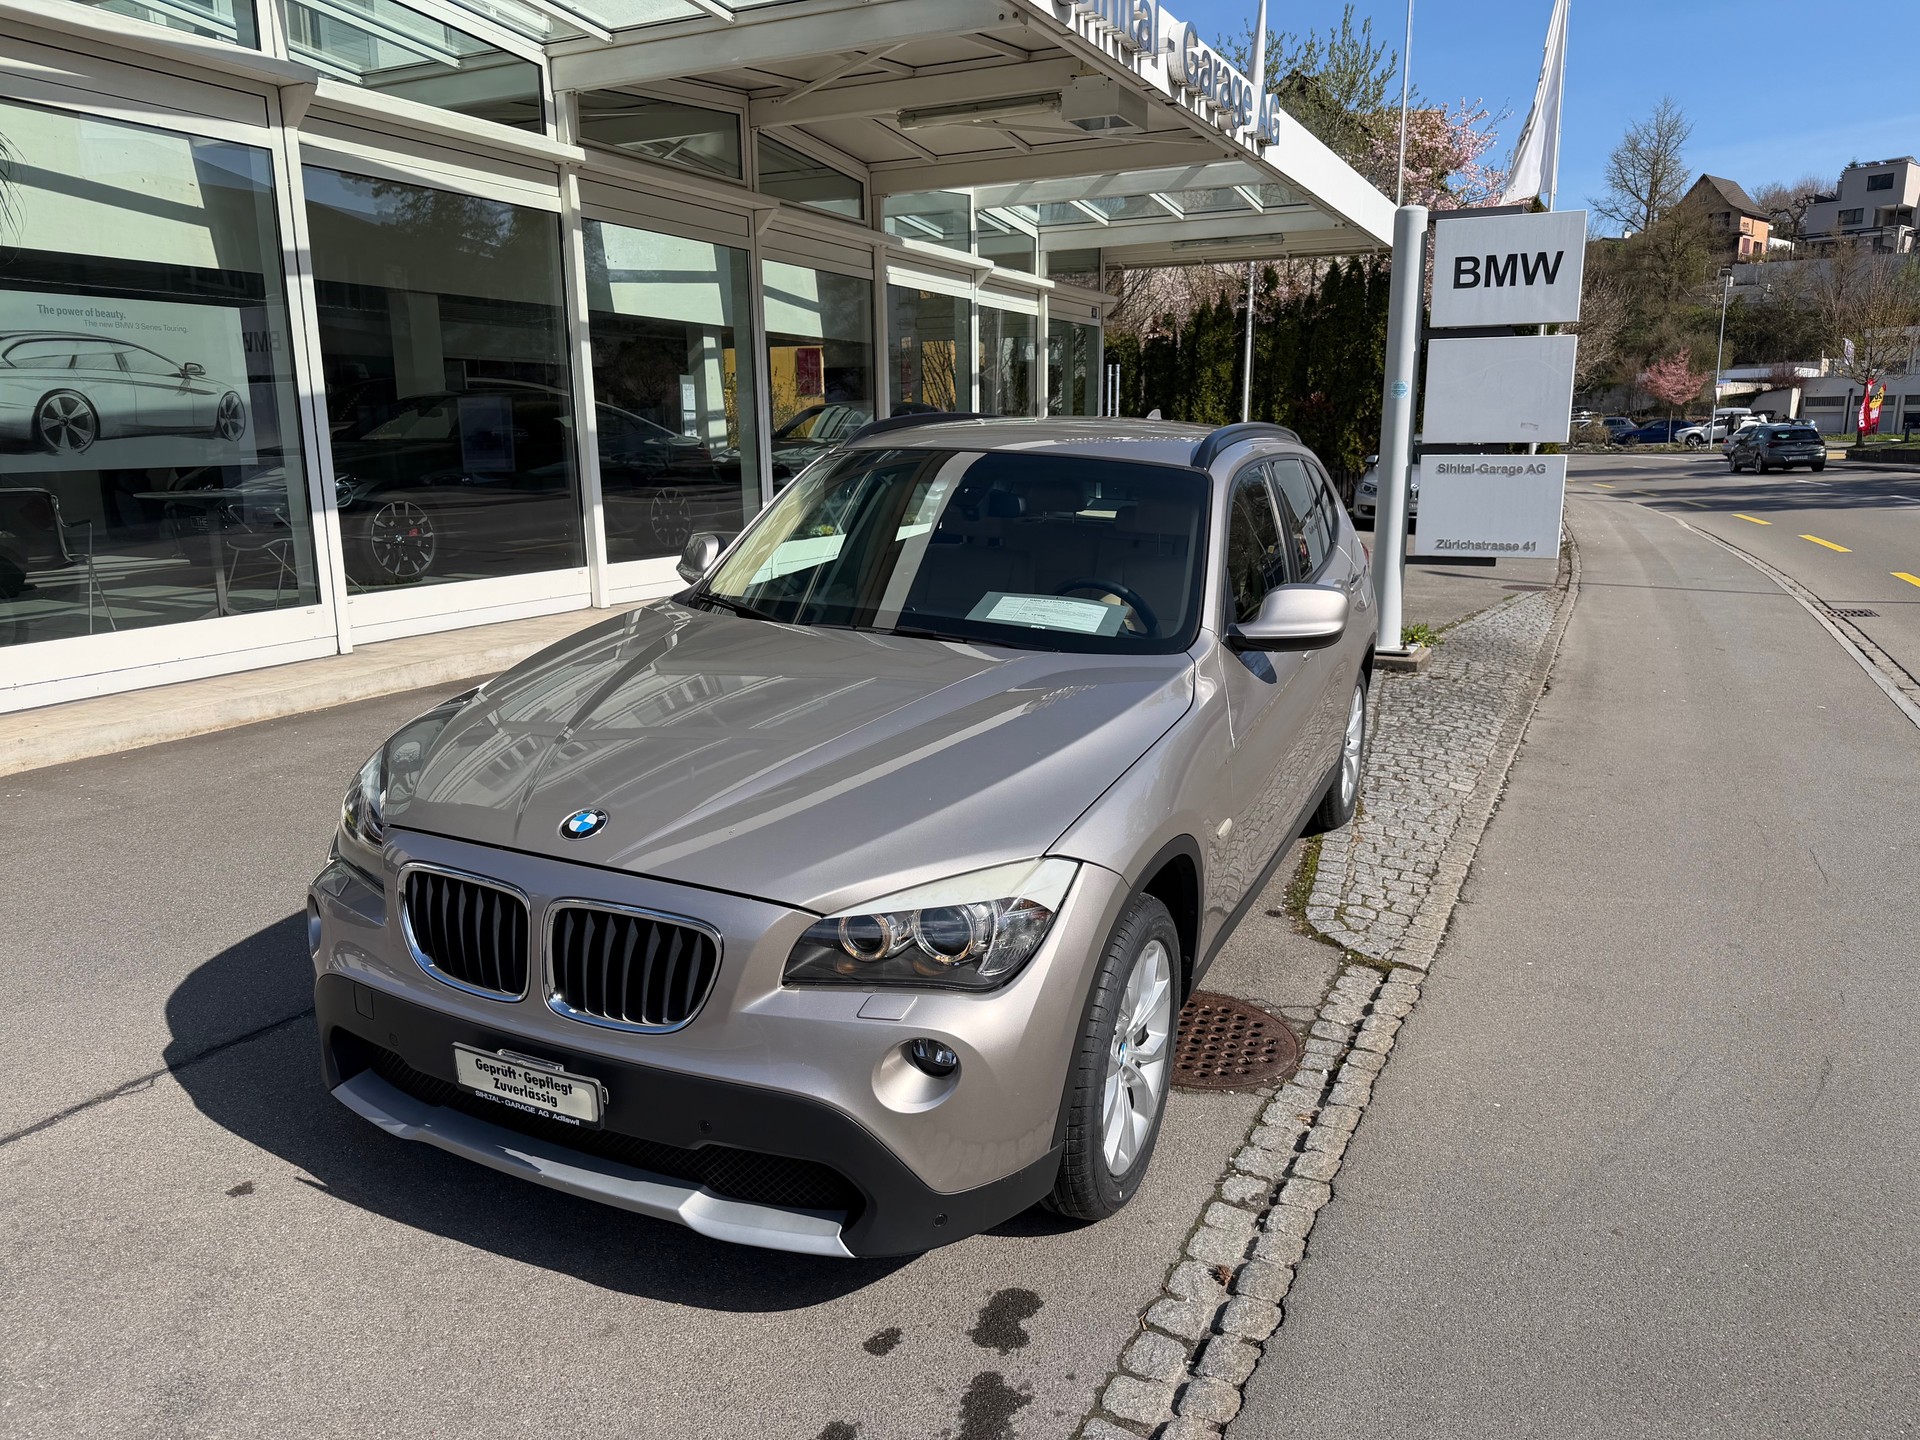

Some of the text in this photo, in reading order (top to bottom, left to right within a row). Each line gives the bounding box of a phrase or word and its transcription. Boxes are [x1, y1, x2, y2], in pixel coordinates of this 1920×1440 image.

[1255, 84, 1280, 146] AG
[1453, 250, 1565, 290] BMW
[36, 304, 127, 321] The power of beauty.
[84, 319, 98, 328] The
[98, 321, 114, 329] new
[114, 320, 134, 330] BMW
[134, 322, 141, 330] 3
[140, 323, 163, 332] Series
[1437, 463, 1547, 477] Sihltal-Garage AG
[1435, 538, 1538, 552] Zürichstrasse 41
[475, 1058, 573, 1096] Geprüft Gepflegt
[492, 1077, 558, 1108] Zuverlässig
[537, 1109, 550, 1118] AG
